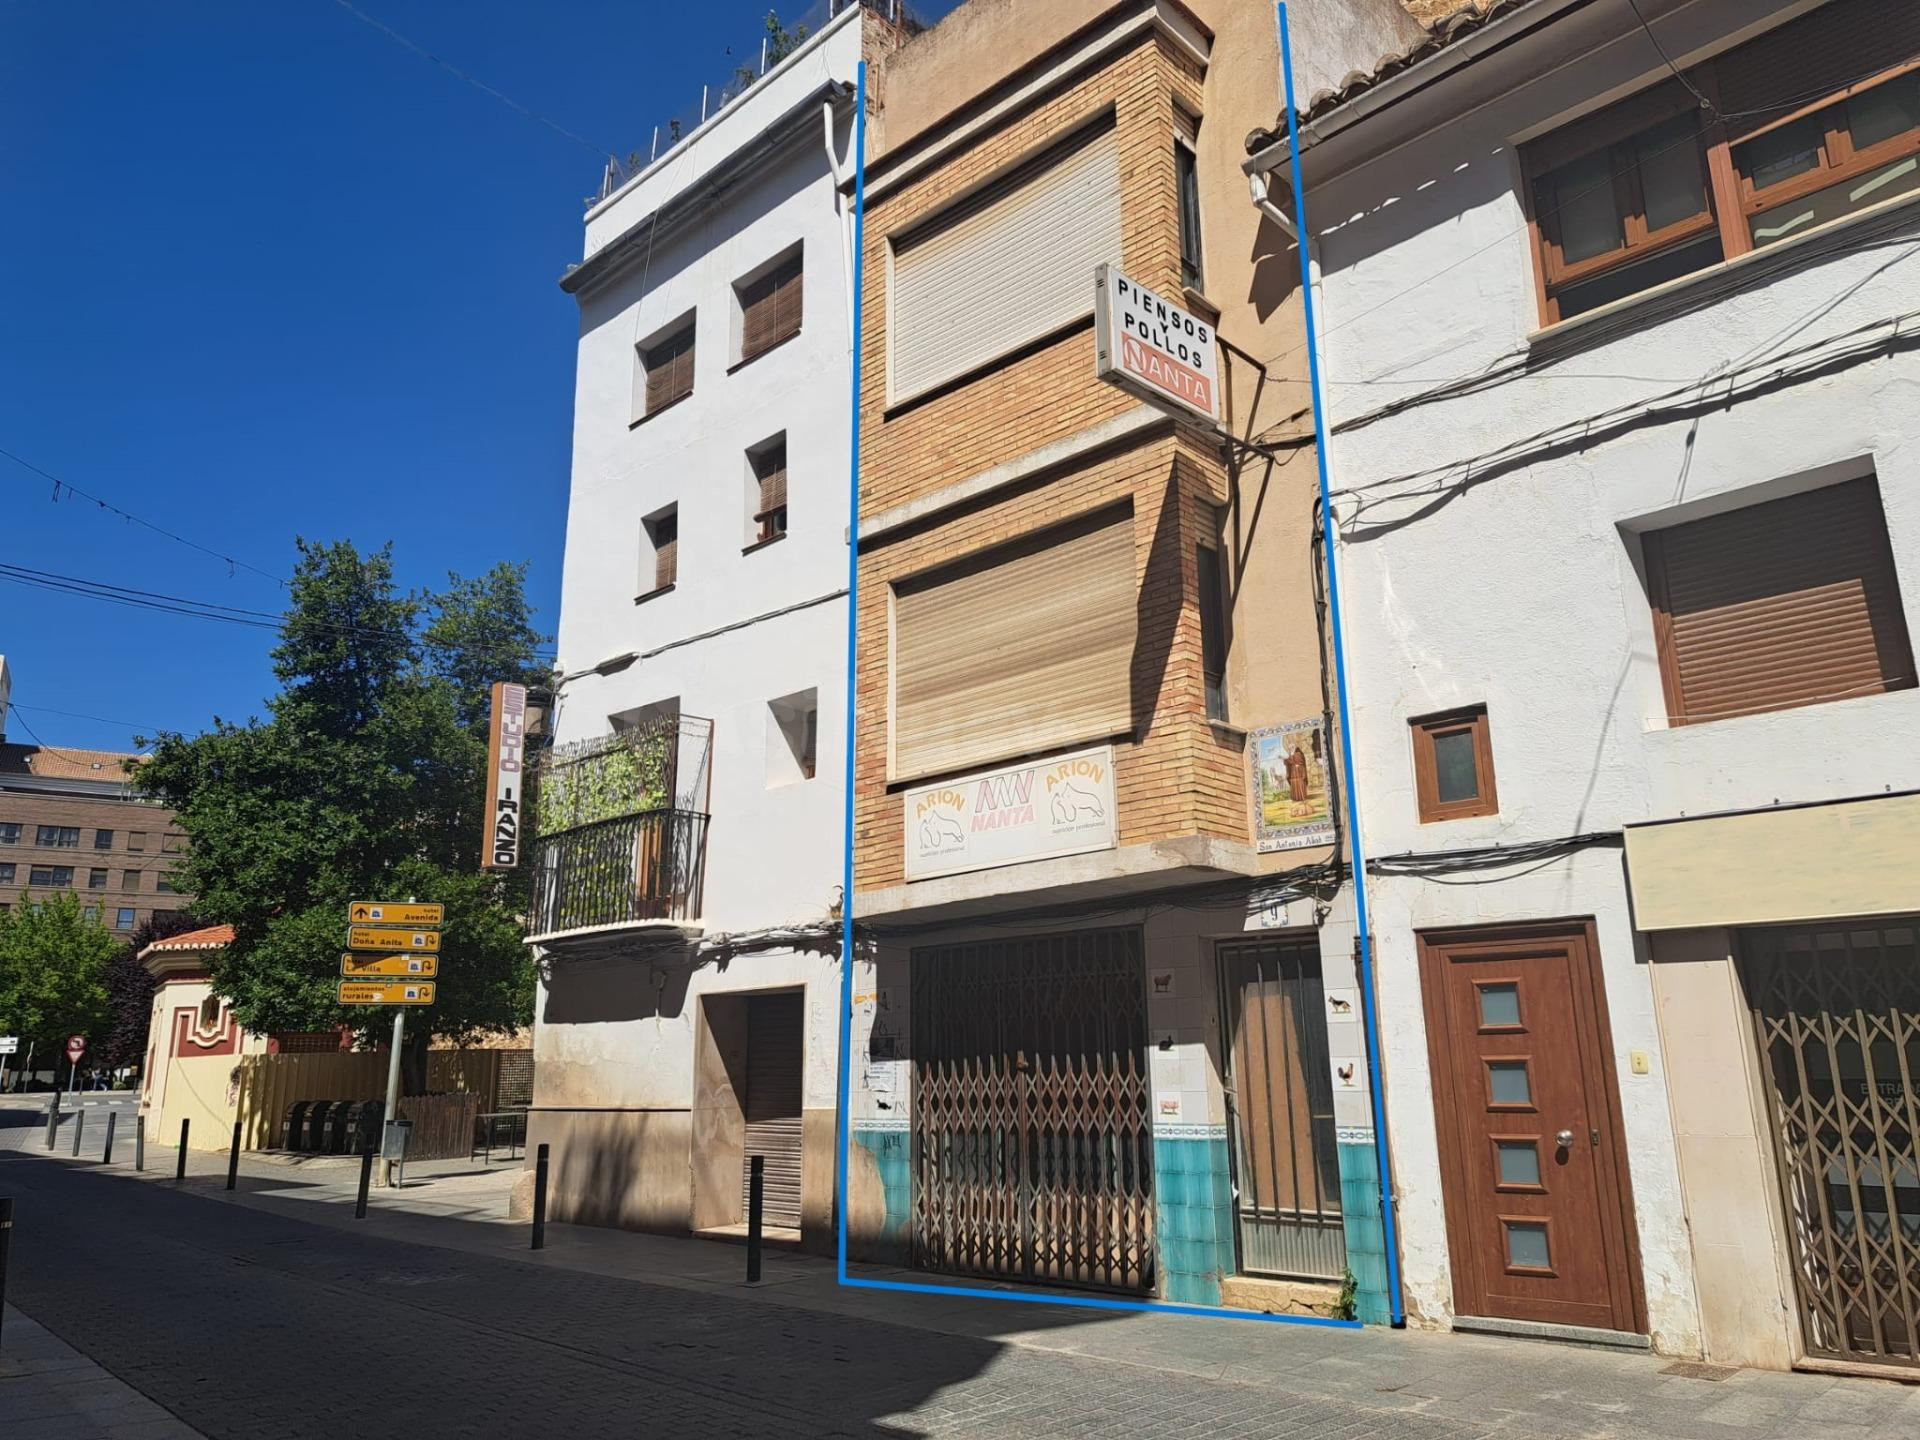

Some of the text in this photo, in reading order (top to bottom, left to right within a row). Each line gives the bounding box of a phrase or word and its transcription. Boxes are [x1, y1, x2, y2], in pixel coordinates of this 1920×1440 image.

[1118, 279, 1208, 344] PIENSOS
[1124, 312, 1202, 369] POLLOS
[1159, 321, 1169, 334] Y
[1124, 337, 1208, 405] NANTA
[495, 686, 524, 865] ESTUDIO IRANZO
[1046, 760, 1105, 793] ARION
[915, 791, 966, 819] ARION
[970, 804, 1034, 832] NANTA
[1259, 842, 1273, 851] San
[1275, 839, 1302, 849] Antonio
[404, 913, 439, 921] Avenida
[353, 937, 402, 946] Doña Anita
